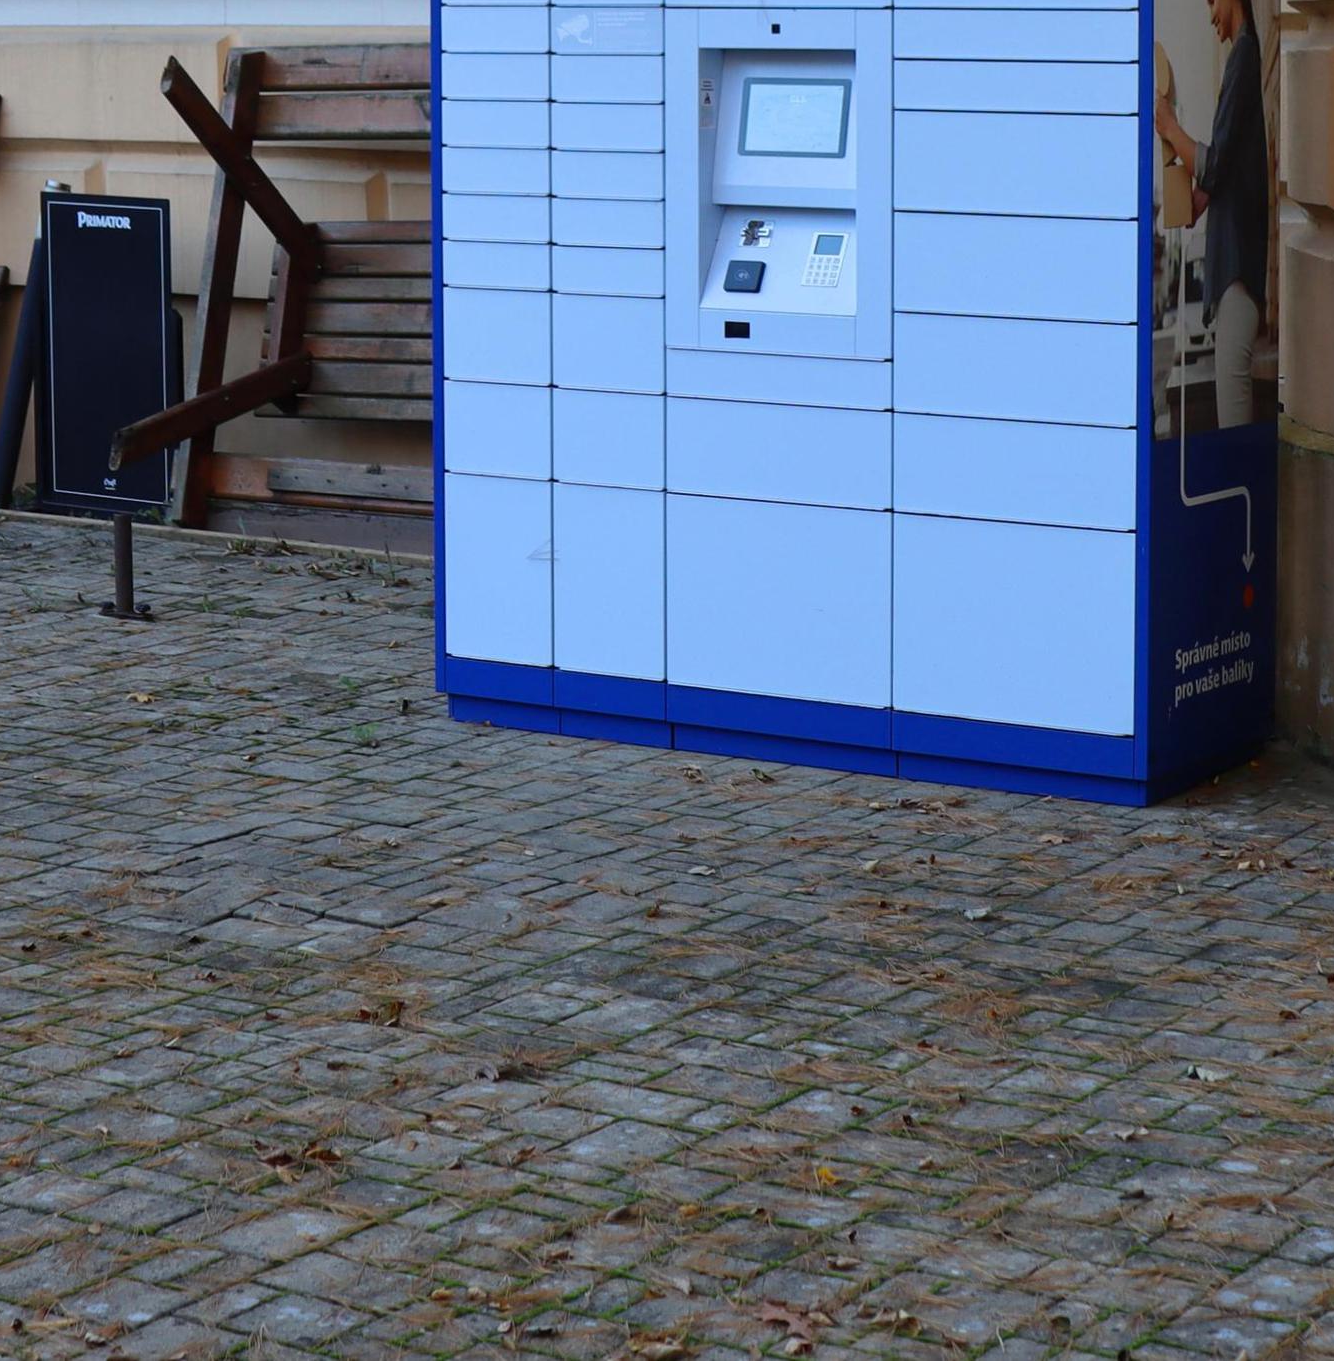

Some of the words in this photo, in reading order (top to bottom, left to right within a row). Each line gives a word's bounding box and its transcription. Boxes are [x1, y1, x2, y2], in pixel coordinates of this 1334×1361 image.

[1175, 636, 1219, 675] Správné
[1221, 631, 1251, 656] místo
[1175, 681, 1194, 708] pro
[1195, 668, 1220, 695] vaše
[1221, 657, 1254, 686] balíky
